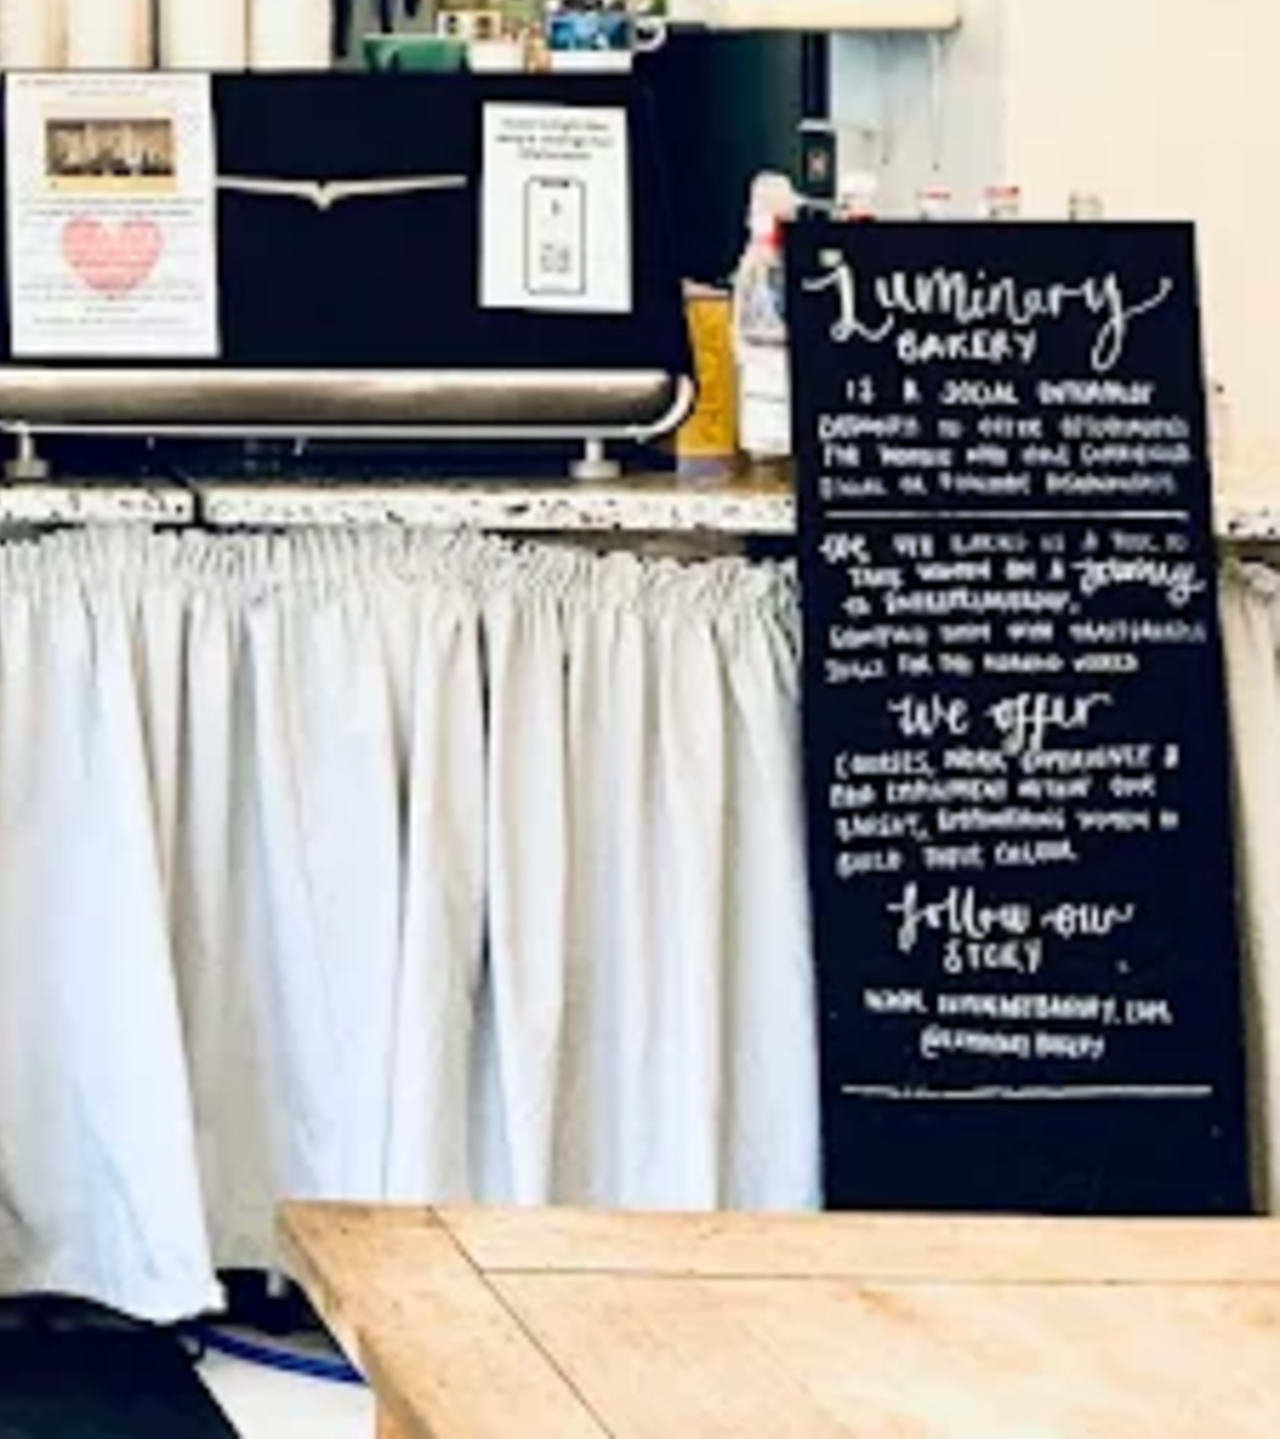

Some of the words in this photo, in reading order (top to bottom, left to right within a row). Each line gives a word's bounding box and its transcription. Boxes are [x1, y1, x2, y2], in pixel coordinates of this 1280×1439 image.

[803, 250, 1172, 371] Luminary
[897, 330, 1036, 361] BAKERY
[846, 376, 875, 404] IS
[903, 379, 921, 403] A
[940, 380, 1019, 407] SOCIAL
[986, 692, 1113, 755] offer
[943, 939, 1042, 973] STORY
